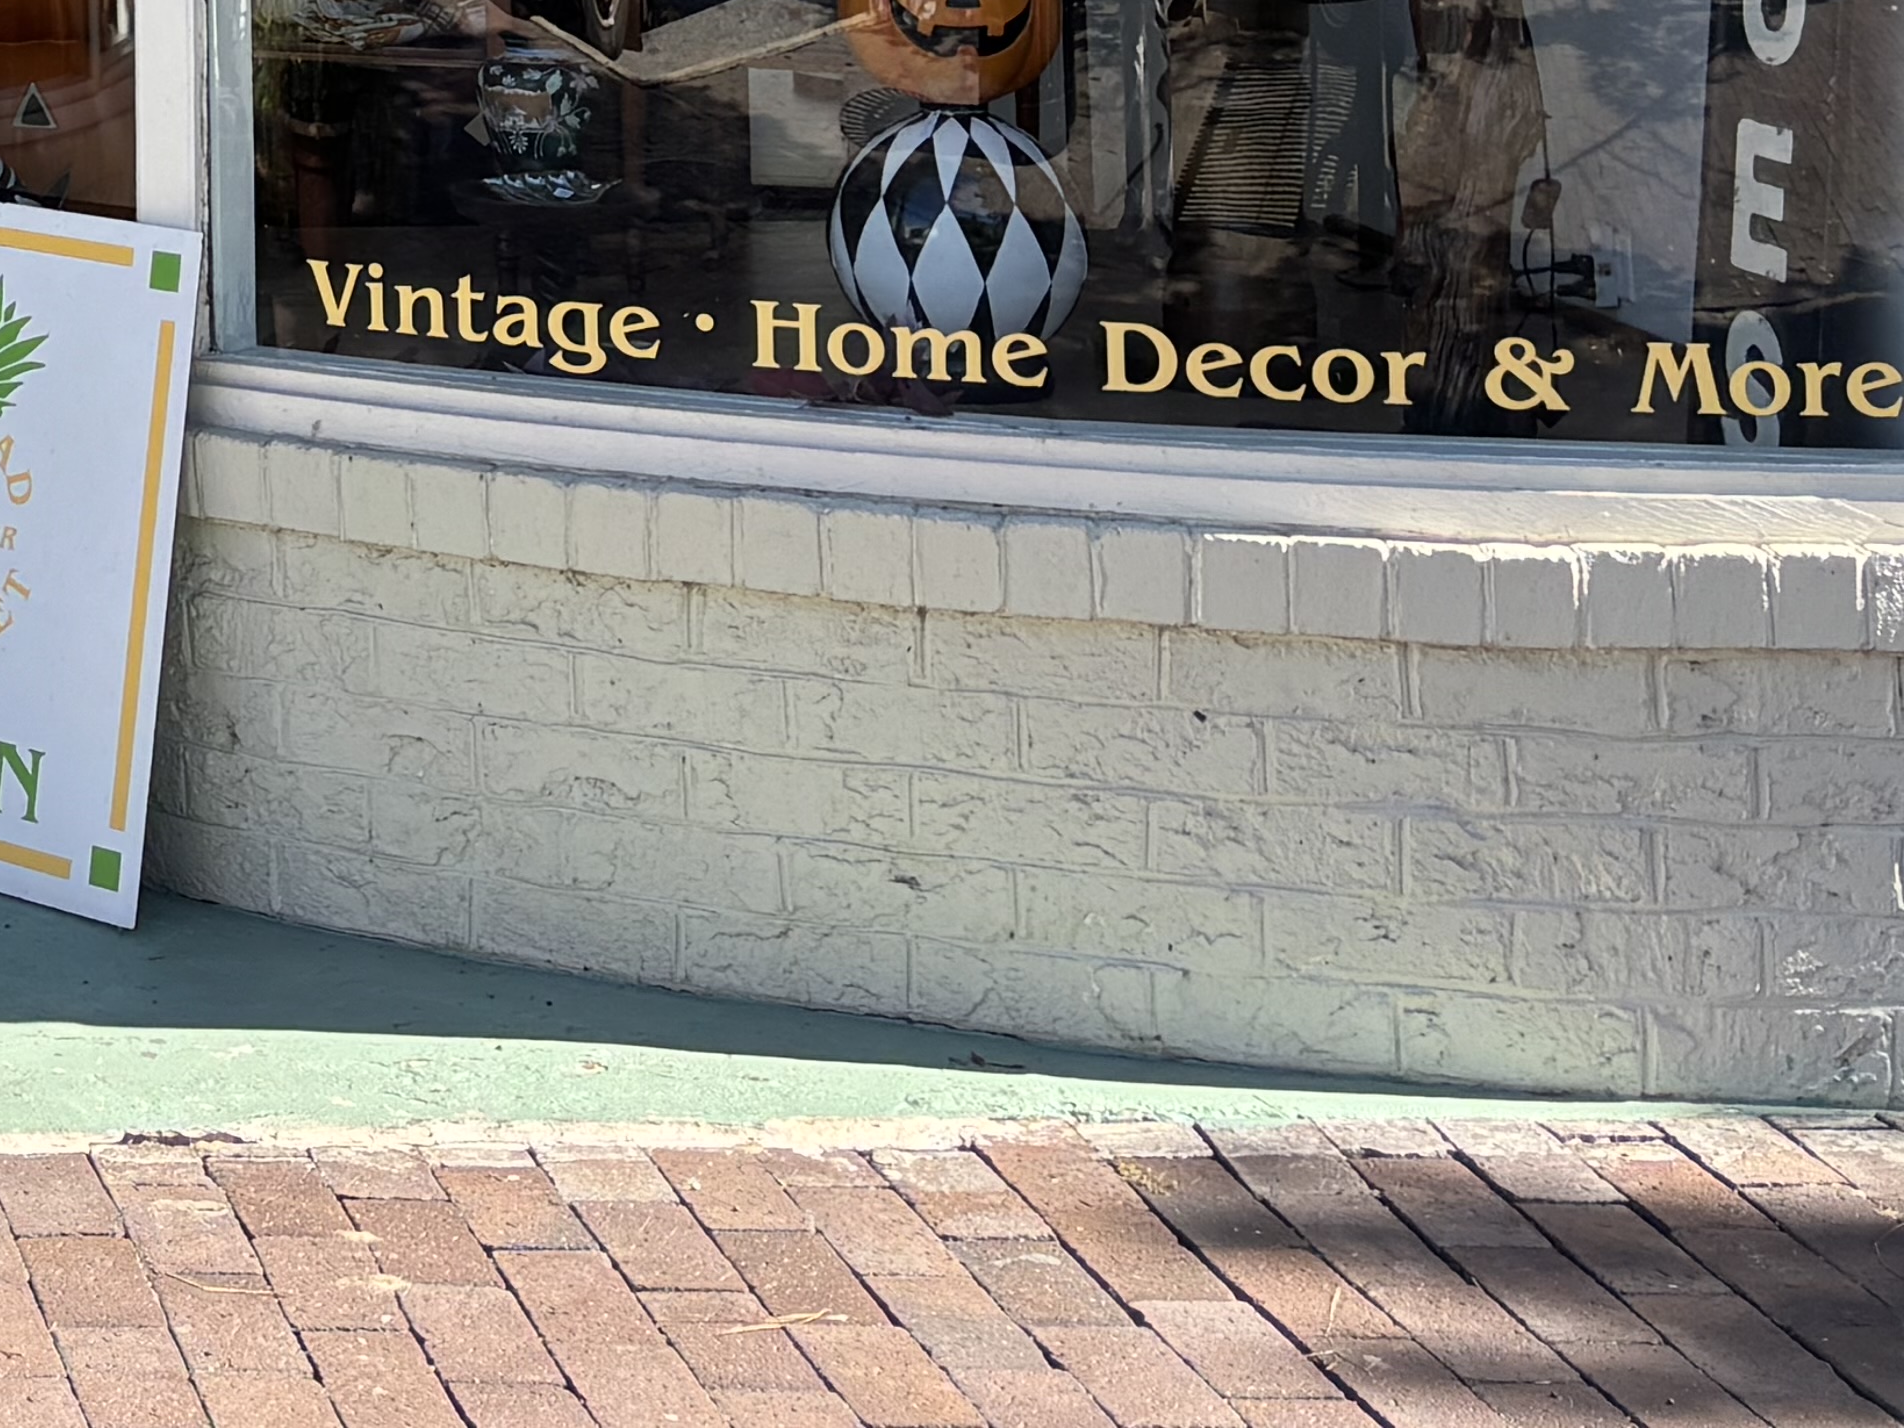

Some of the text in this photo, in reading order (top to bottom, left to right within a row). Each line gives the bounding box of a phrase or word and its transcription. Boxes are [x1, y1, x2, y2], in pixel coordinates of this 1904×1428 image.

[306, 258, 1903, 418] Vintage Home Decor & More
